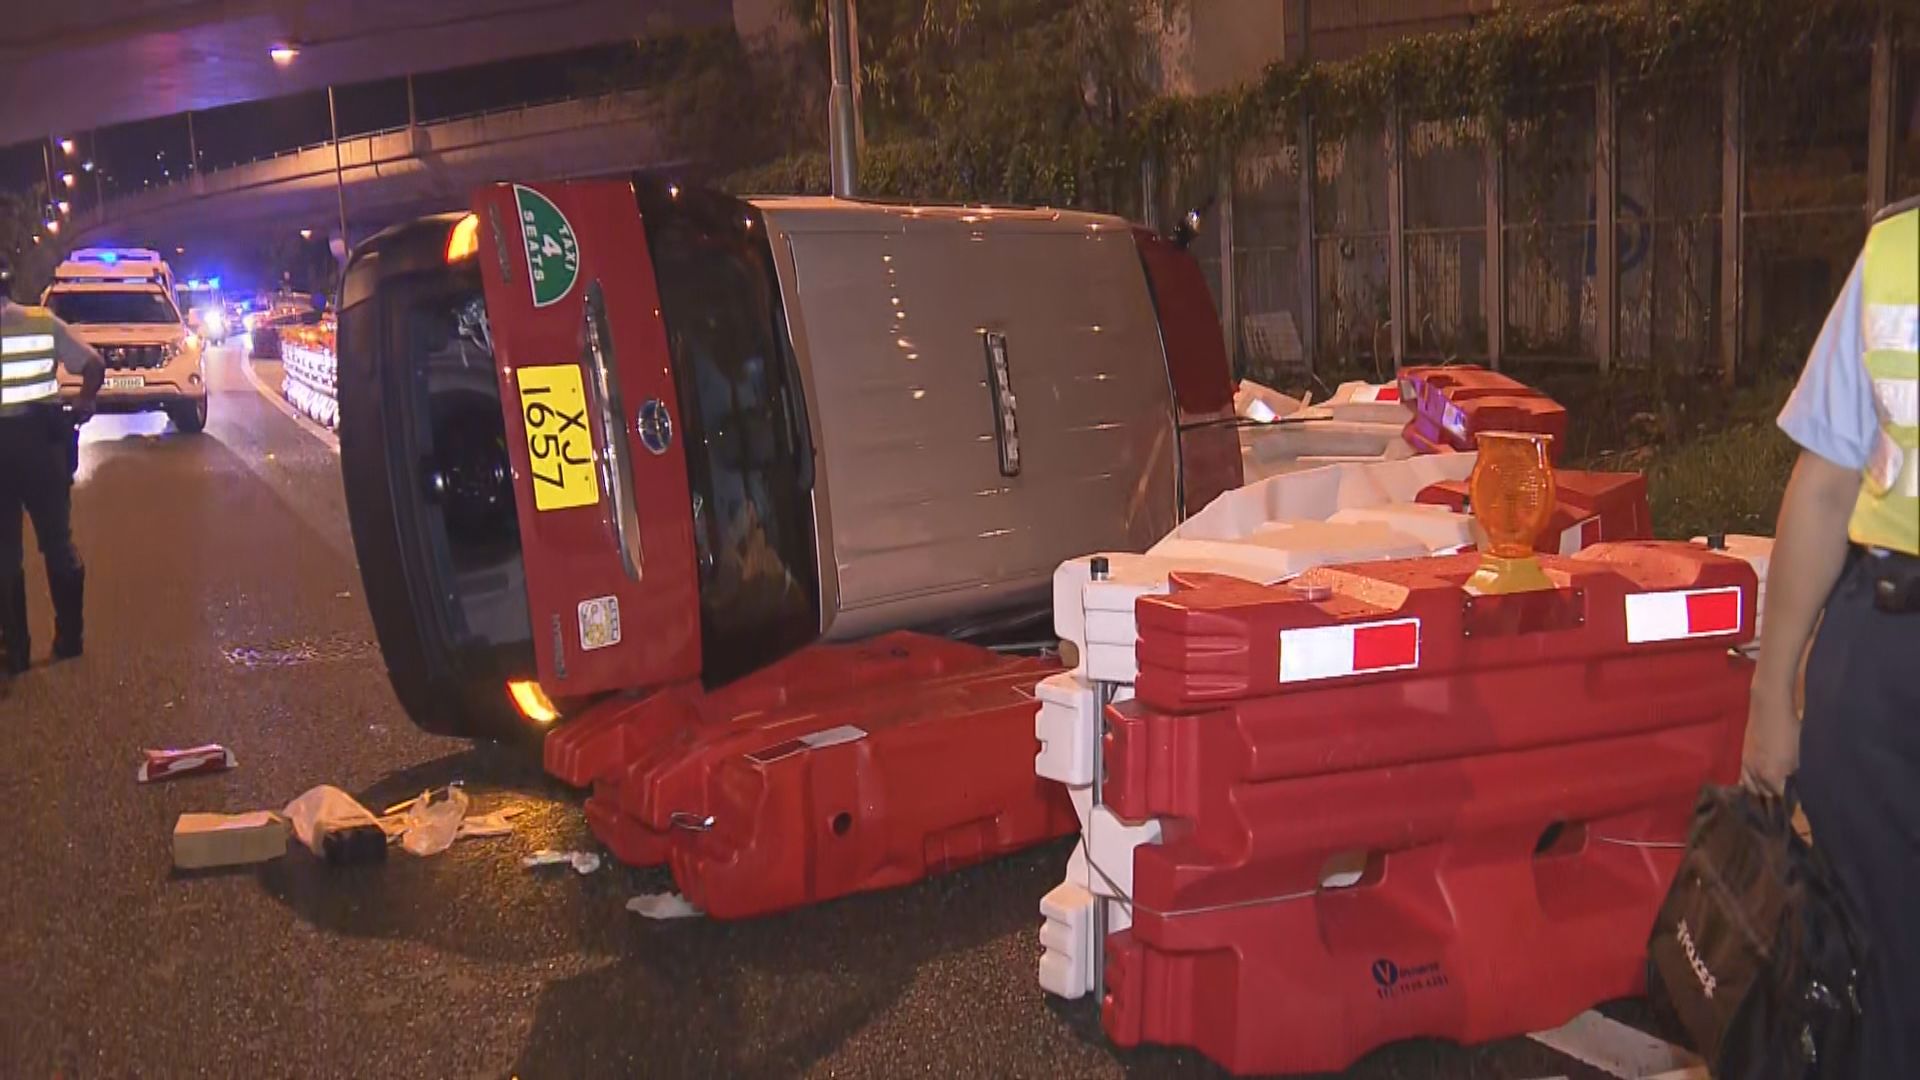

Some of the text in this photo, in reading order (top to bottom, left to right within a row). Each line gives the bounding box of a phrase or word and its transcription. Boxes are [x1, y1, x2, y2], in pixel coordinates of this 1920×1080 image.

[523, 209, 545, 281] SEATS
[541, 233, 562, 257] 4
[558, 223, 576, 271] TAXI
[521, 386, 565, 489] 1657
[555, 409, 592, 465] XJ
